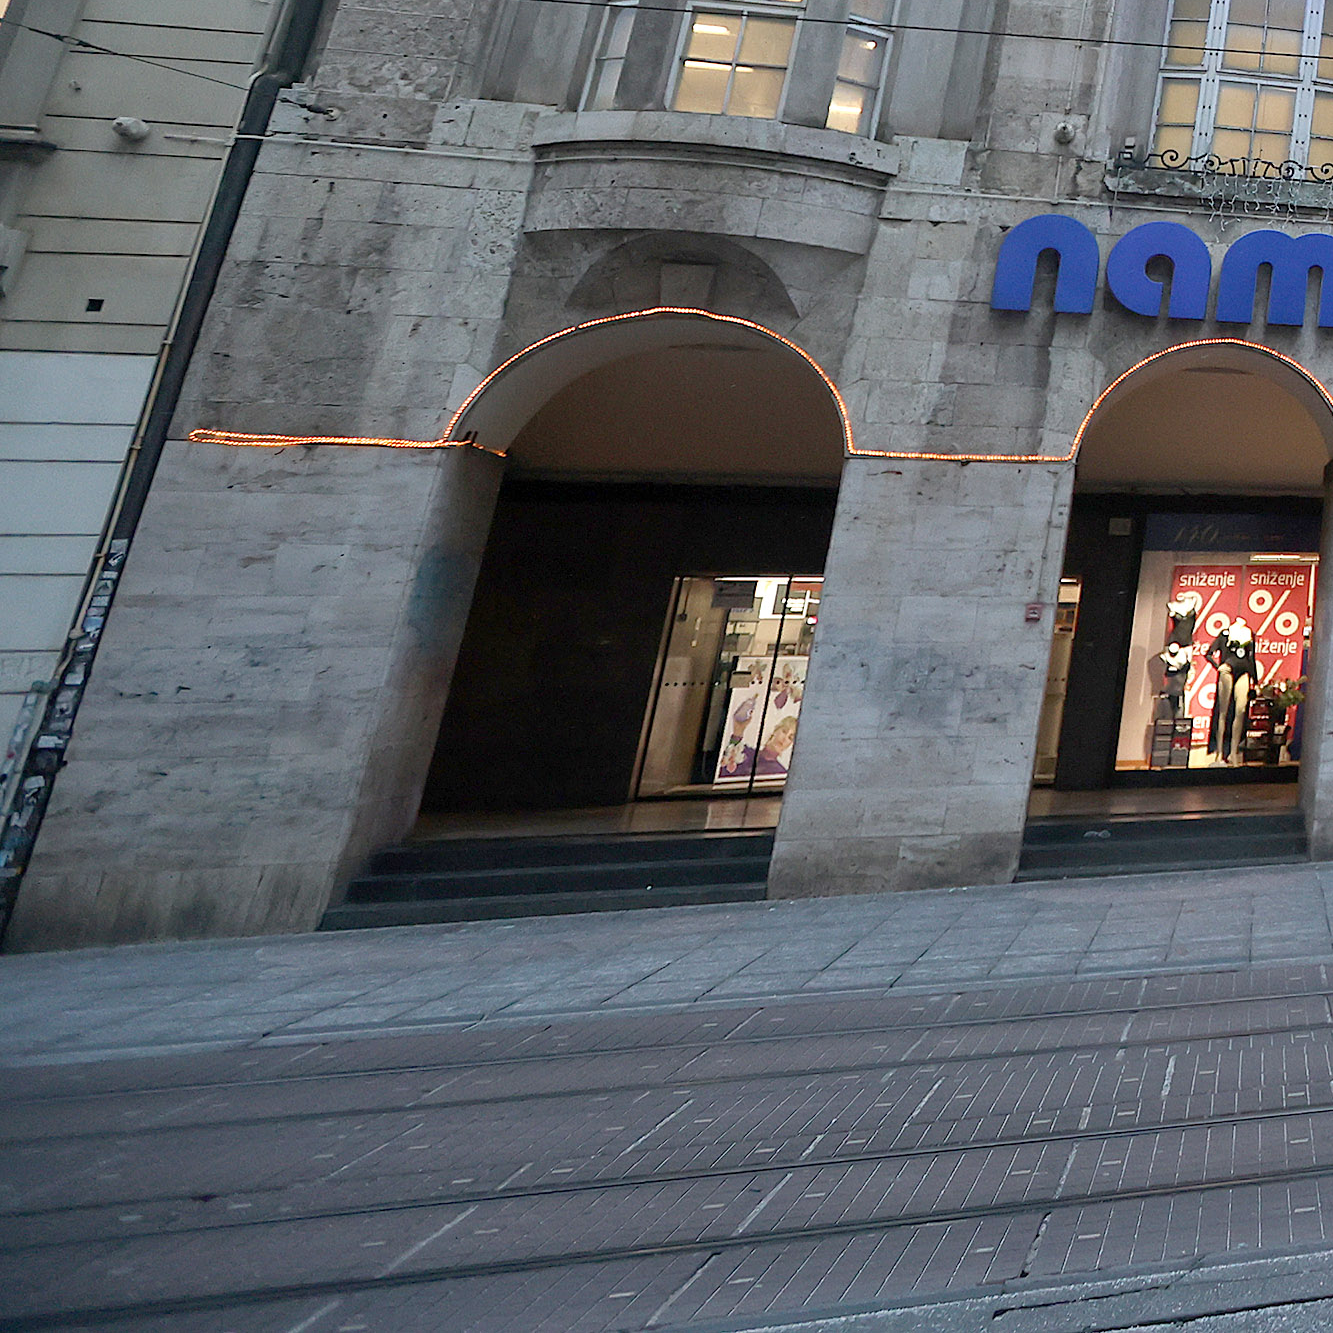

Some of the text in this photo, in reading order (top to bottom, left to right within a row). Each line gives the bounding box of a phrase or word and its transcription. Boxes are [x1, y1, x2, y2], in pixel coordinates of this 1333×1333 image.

[1179, 571, 1236, 589] sniženje
[1250, 571, 1305, 589] sniženje
[1254, 639, 1298, 657] niženje
